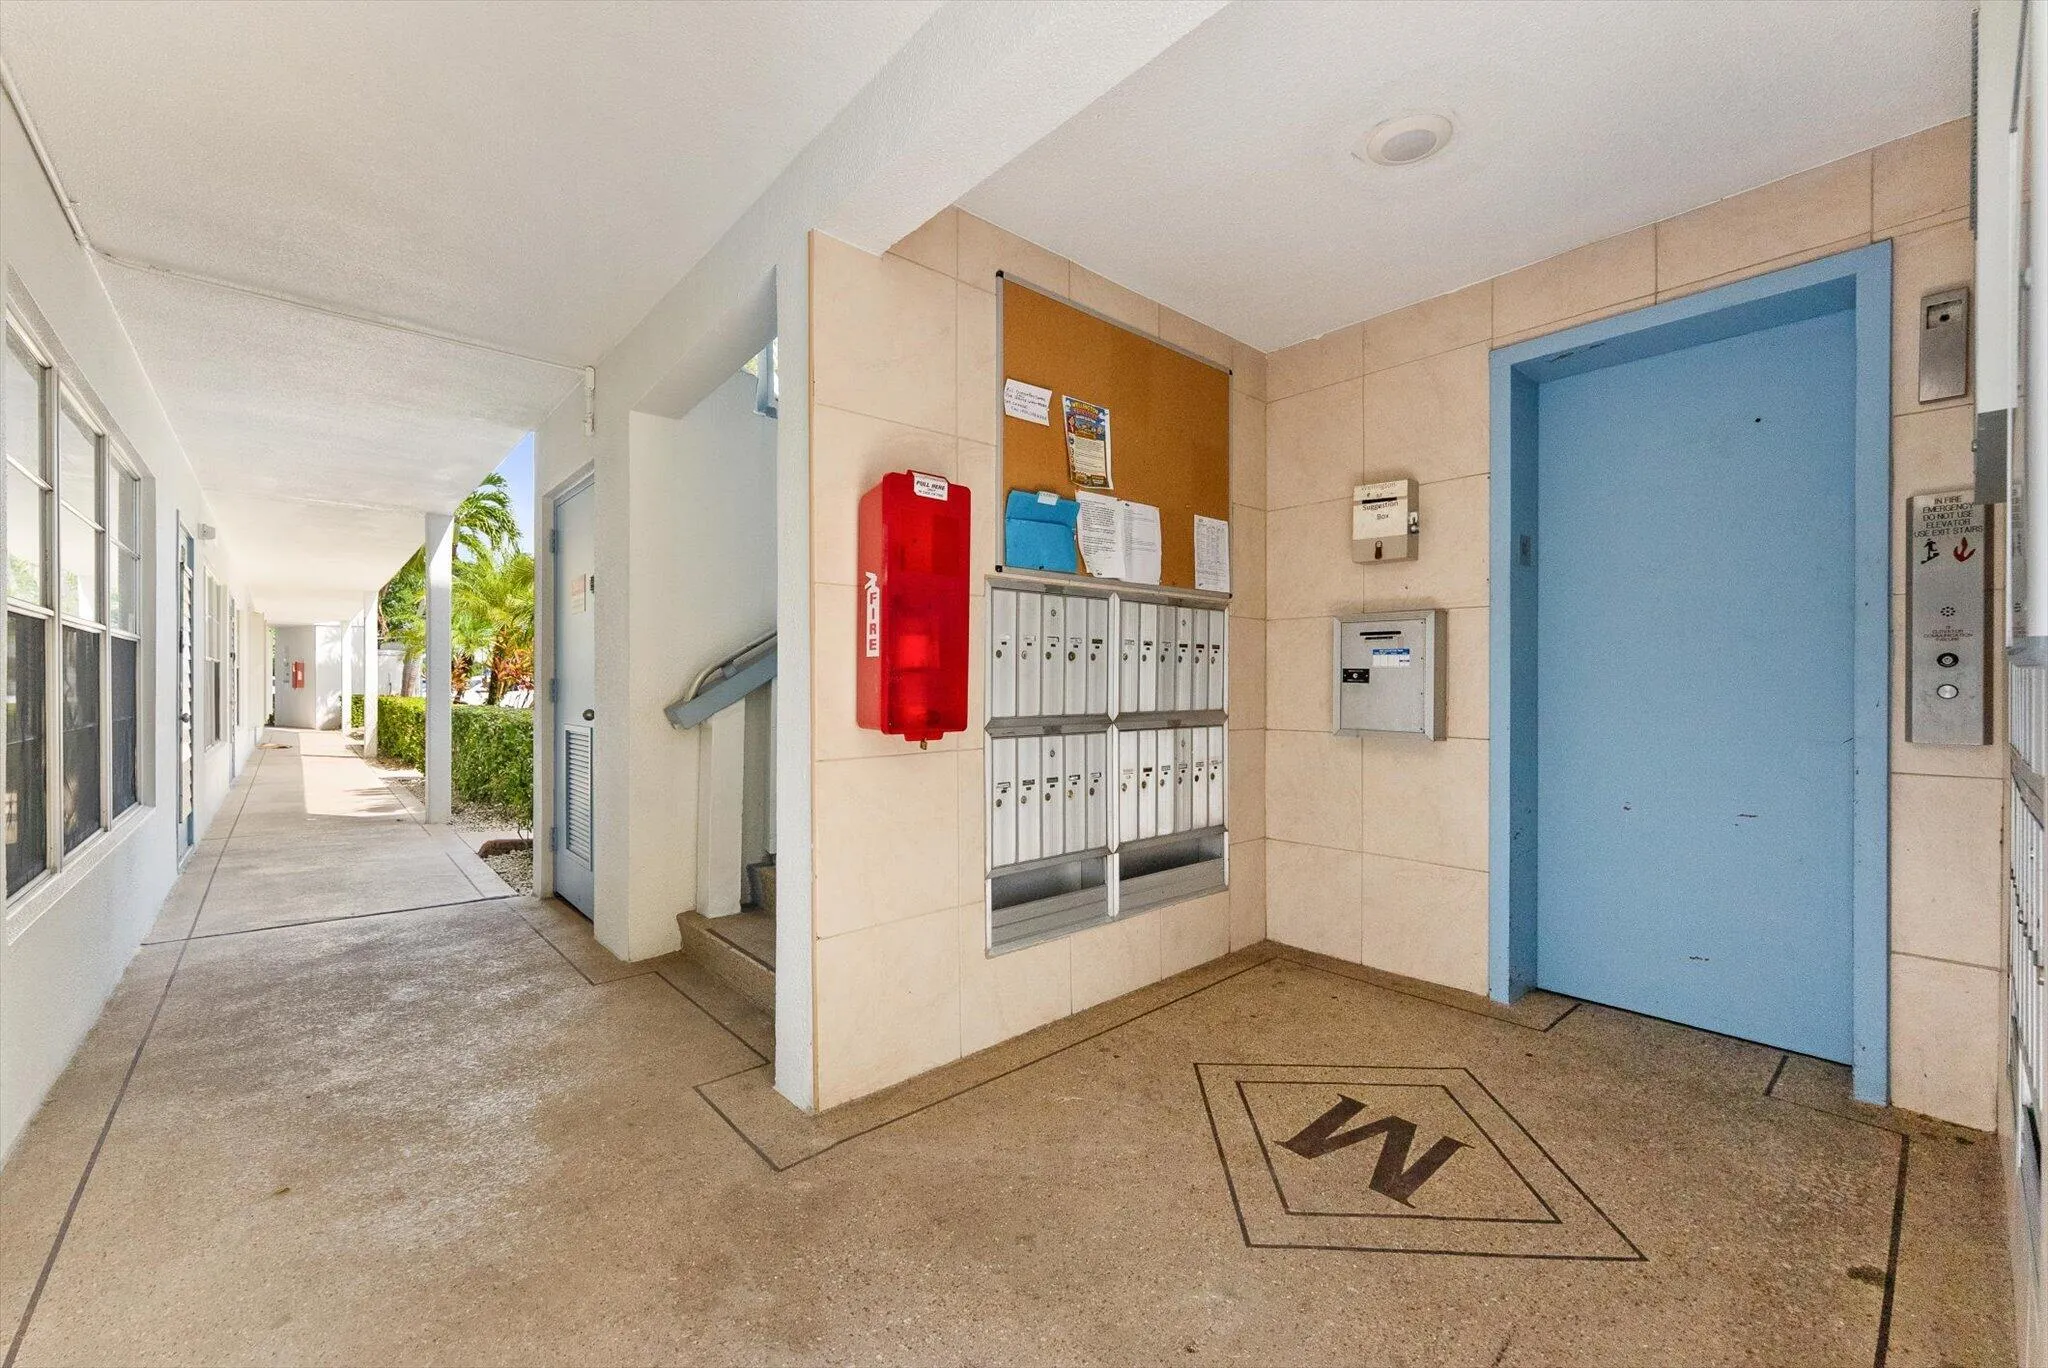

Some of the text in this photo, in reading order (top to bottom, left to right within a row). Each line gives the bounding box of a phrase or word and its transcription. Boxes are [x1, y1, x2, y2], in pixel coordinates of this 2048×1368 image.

[1944, 495, 1963, 504] FIRE
[1923, 502, 1975, 513] EMERGENCY
[1923, 510, 1973, 521] DO NOT USE
[1926, 518, 1971, 529] ELEVATOR
[1914, 525, 1984, 538] USE EXIT STAIRS
[869, 592, 877, 650] FIRE
[1272, 1093, 1475, 1208] M
